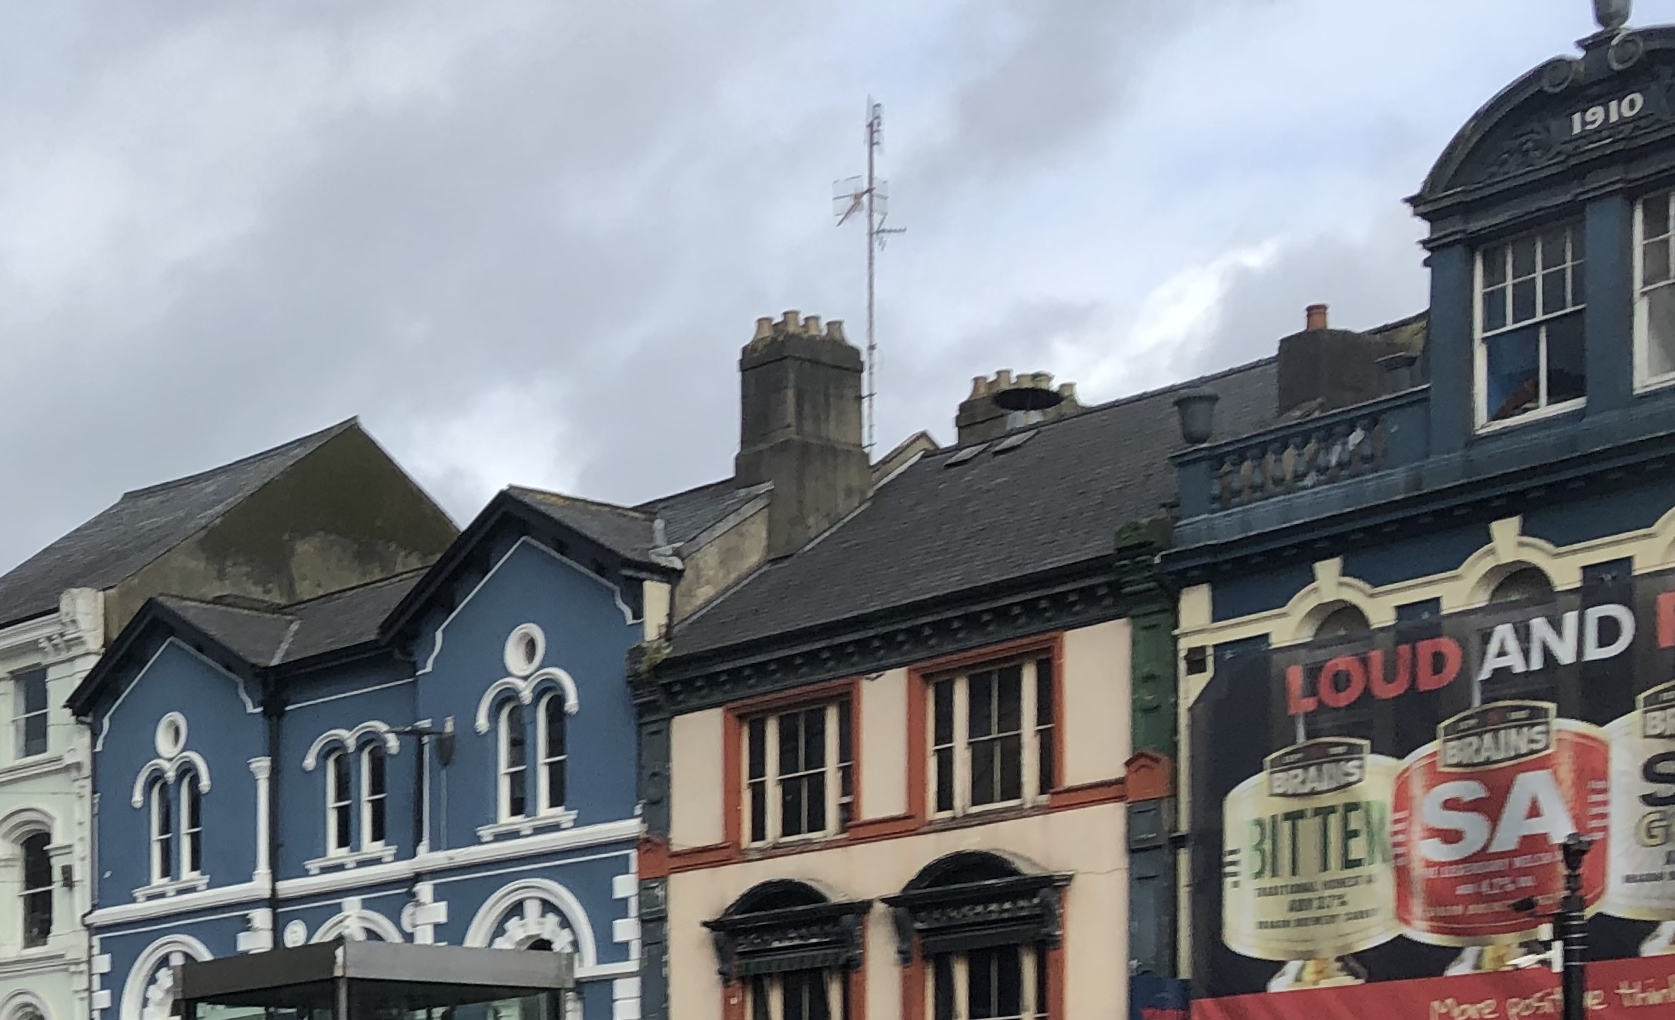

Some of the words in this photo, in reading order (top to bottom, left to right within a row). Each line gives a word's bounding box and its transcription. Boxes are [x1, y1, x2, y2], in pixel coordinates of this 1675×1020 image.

[1571, 92, 1644, 135] 1910
[1286, 636, 1462, 716] LOUD
[1477, 603, 1636, 681] AND
[1444, 725, 1548, 766] BRAINS
[1272, 759, 1360, 794] BRAINS
[1418, 769, 1580, 861] SA
